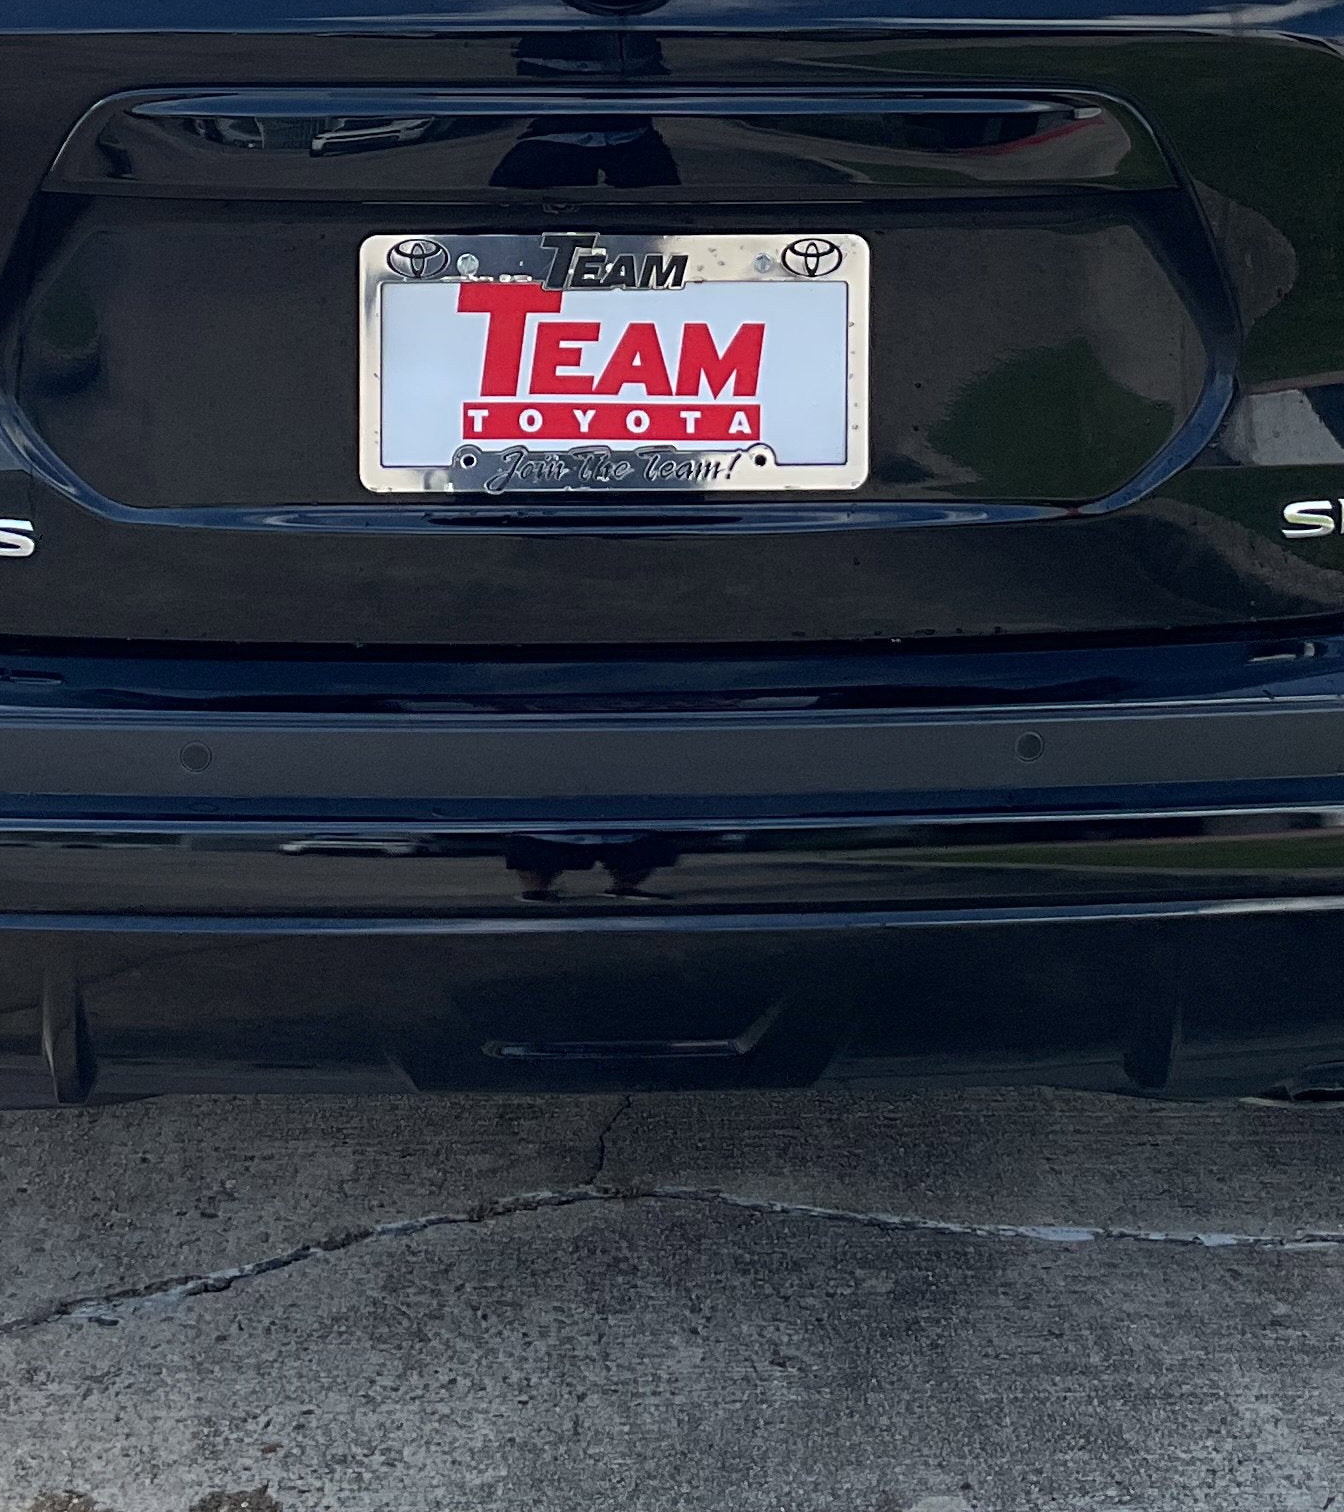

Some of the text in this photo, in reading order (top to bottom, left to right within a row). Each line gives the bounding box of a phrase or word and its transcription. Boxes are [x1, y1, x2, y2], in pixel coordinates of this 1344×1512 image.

[542, 233, 690, 290] TEAM
[457, 282, 765, 400] TEAM
[467, 408, 752, 434] TOYOTA
[485, 445, 743, 493] Join The Team!
